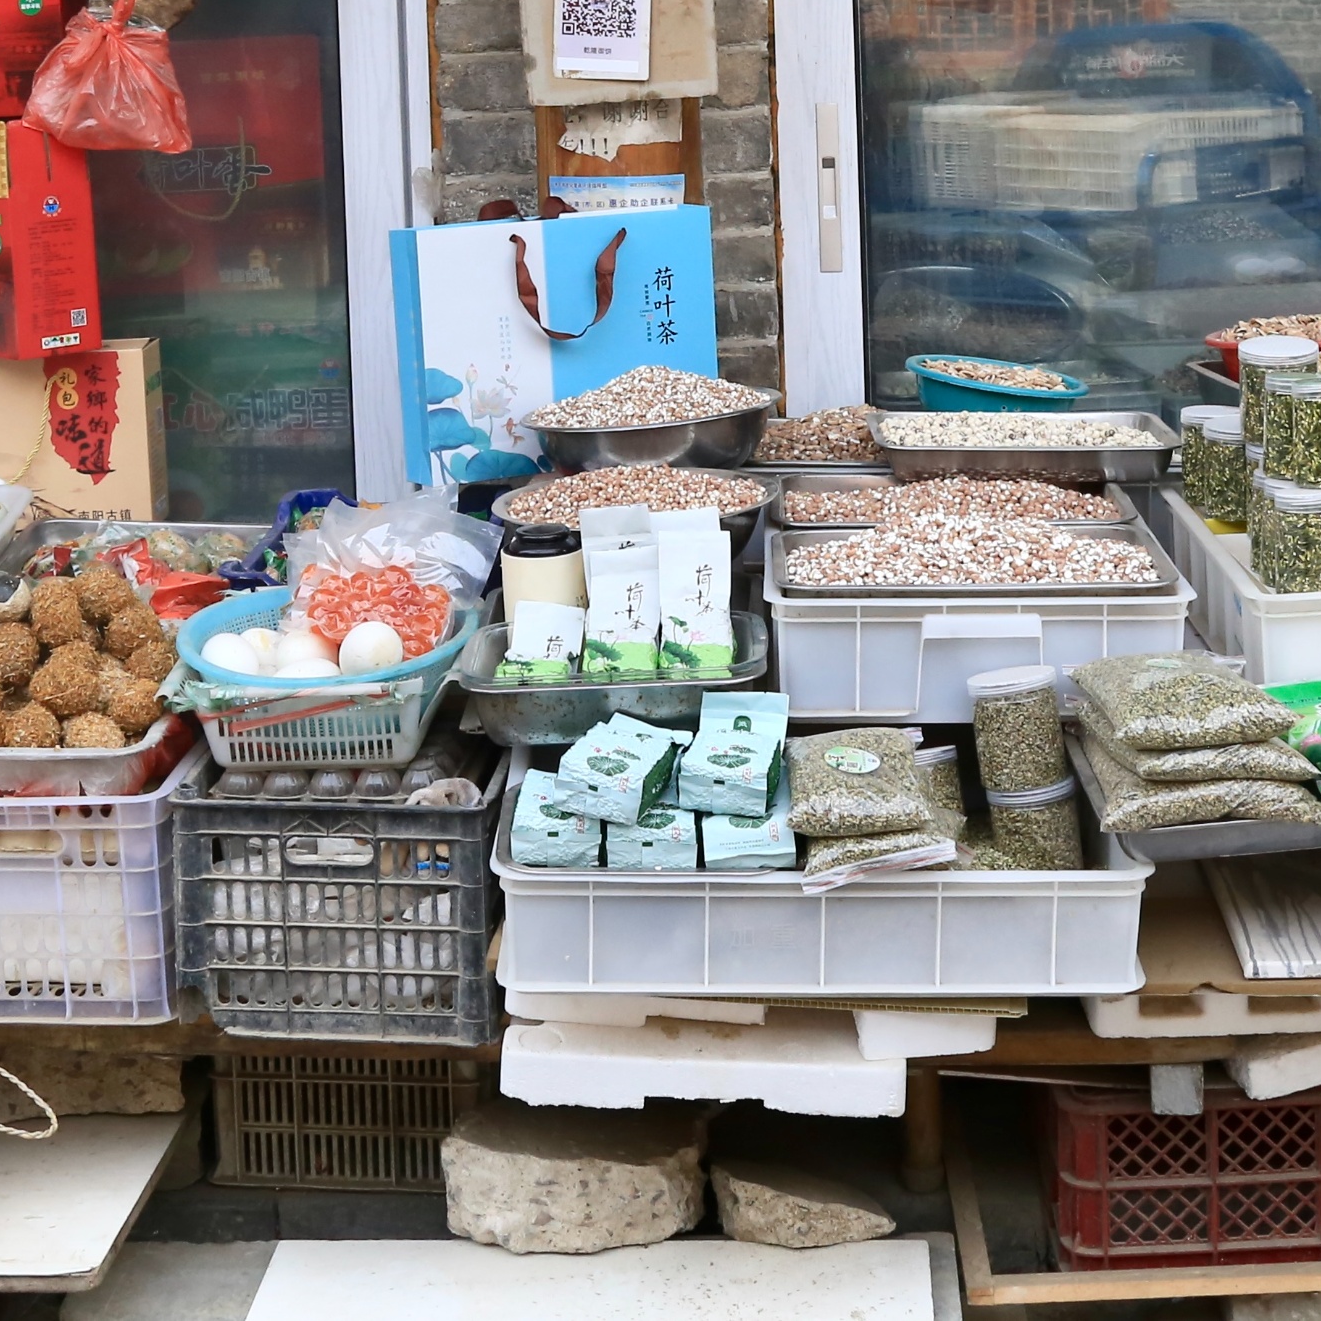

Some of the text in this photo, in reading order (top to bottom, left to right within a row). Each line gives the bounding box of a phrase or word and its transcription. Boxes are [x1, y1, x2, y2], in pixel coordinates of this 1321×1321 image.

[652, 266, 679, 345] 荷叶茶
[60, 371, 76, 407] 礼包
